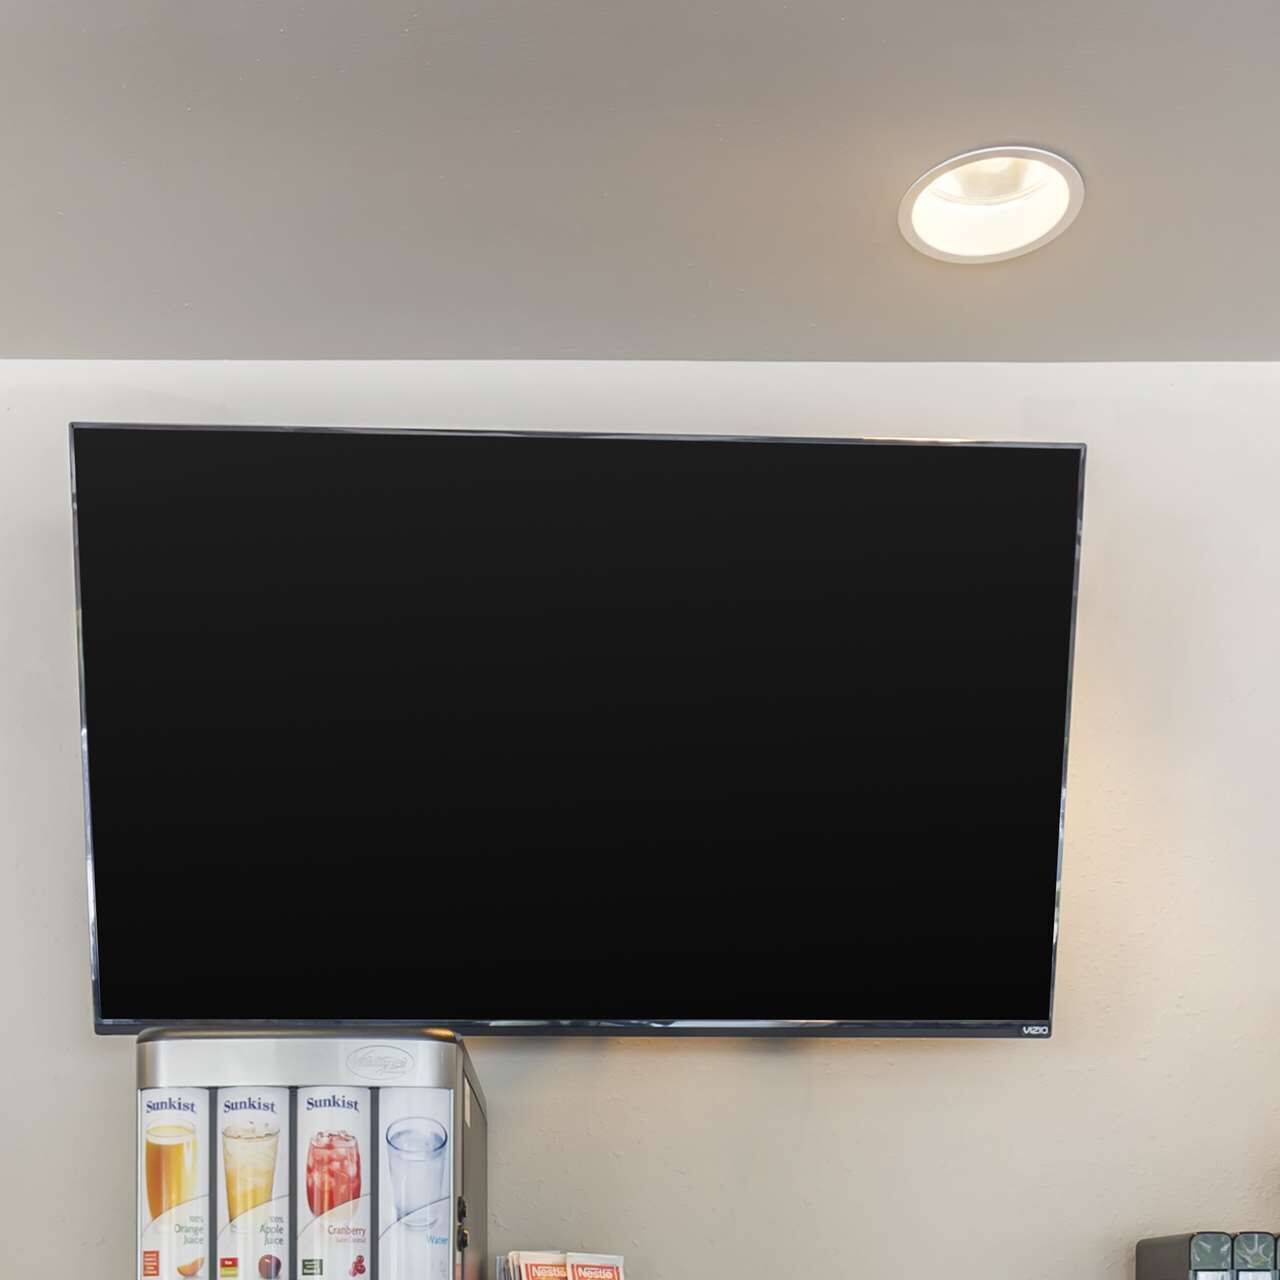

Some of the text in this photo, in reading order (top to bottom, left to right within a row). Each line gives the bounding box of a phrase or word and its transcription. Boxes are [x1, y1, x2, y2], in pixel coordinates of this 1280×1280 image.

[1022, 1025, 1049, 1035] VIZIO
[146, 1097, 197, 1114] Sunkist
[223, 1096, 277, 1114] Sunkist
[306, 1094, 360, 1112] Sunkist
[174, 1223, 205, 1237] Orange
[259, 1223, 285, 1237] Apple
[327, 1224, 367, 1237] Cranberry
